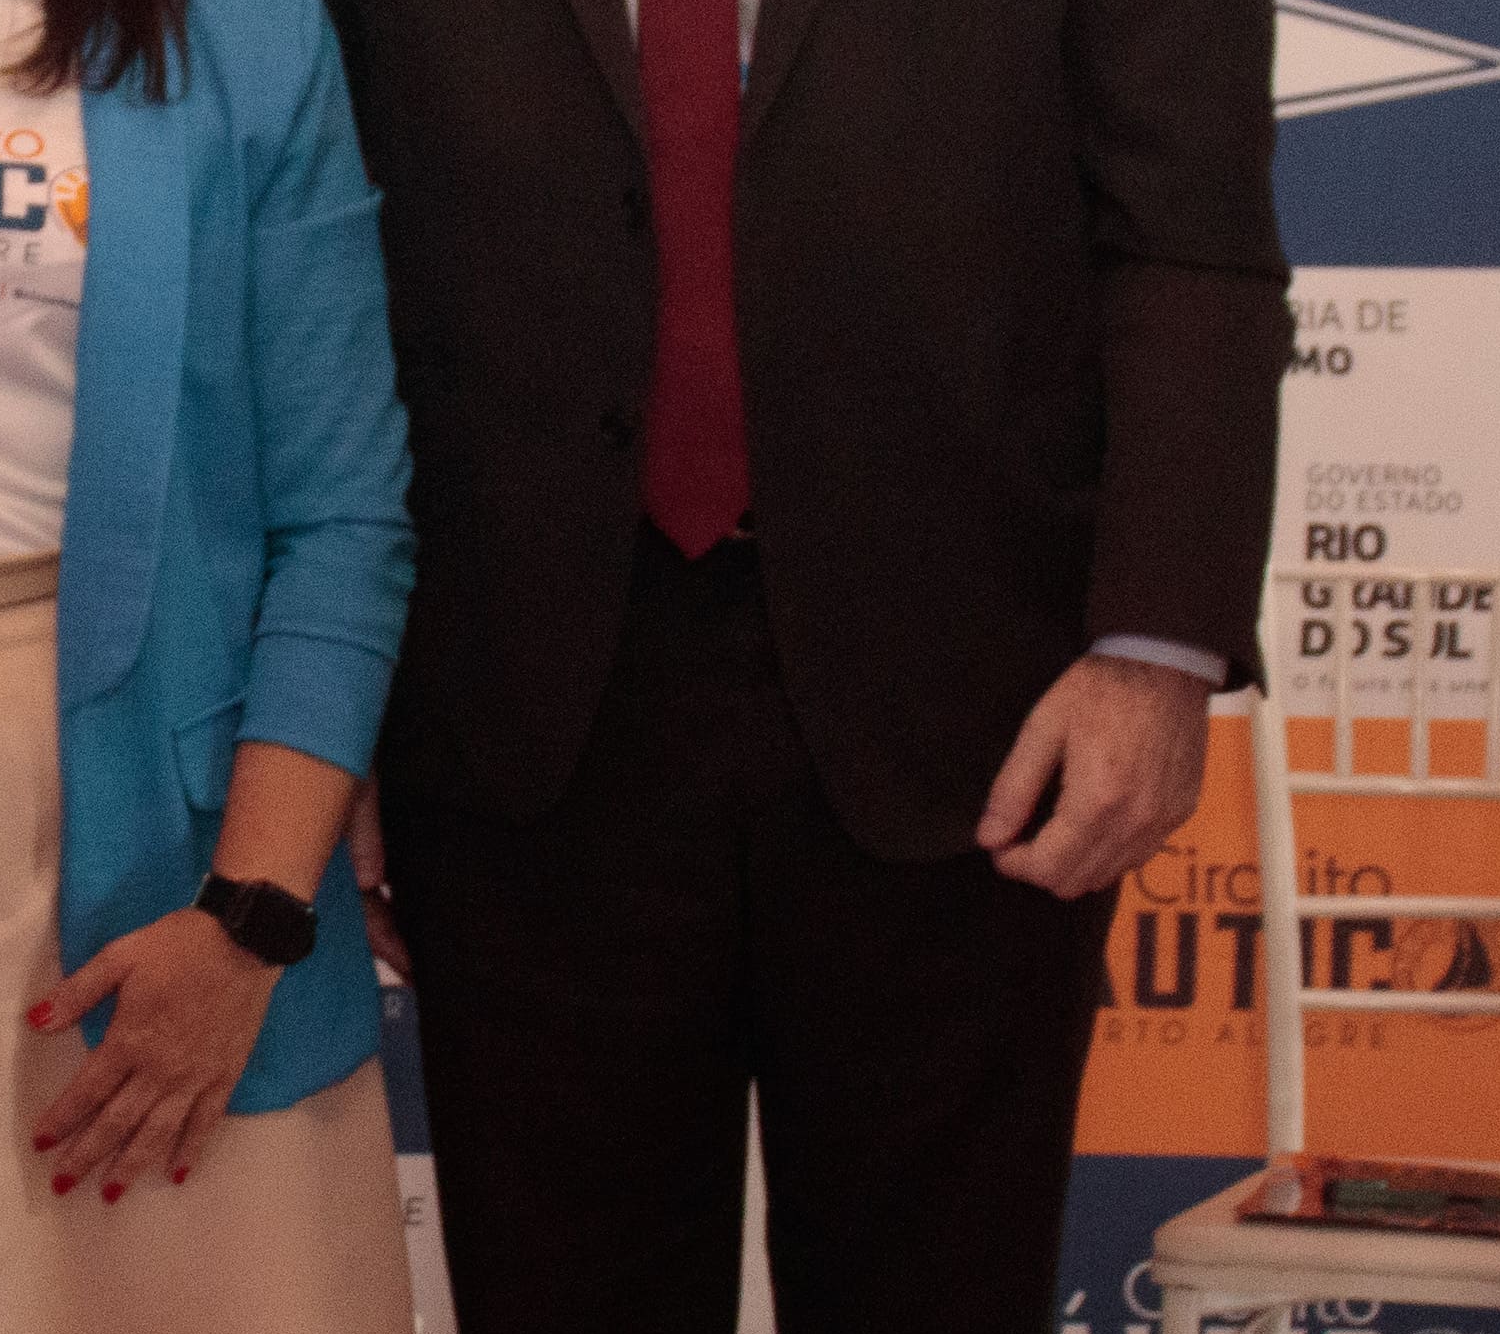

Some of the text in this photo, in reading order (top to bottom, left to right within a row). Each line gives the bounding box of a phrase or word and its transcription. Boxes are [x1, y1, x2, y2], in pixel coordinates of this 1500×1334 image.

[1357, 299, 1408, 333] DE
[1306, 463, 1441, 487] GOVERNO
[1305, 489, 1462, 515] DO ESTADO
[1305, 523, 1386, 561] RIO
